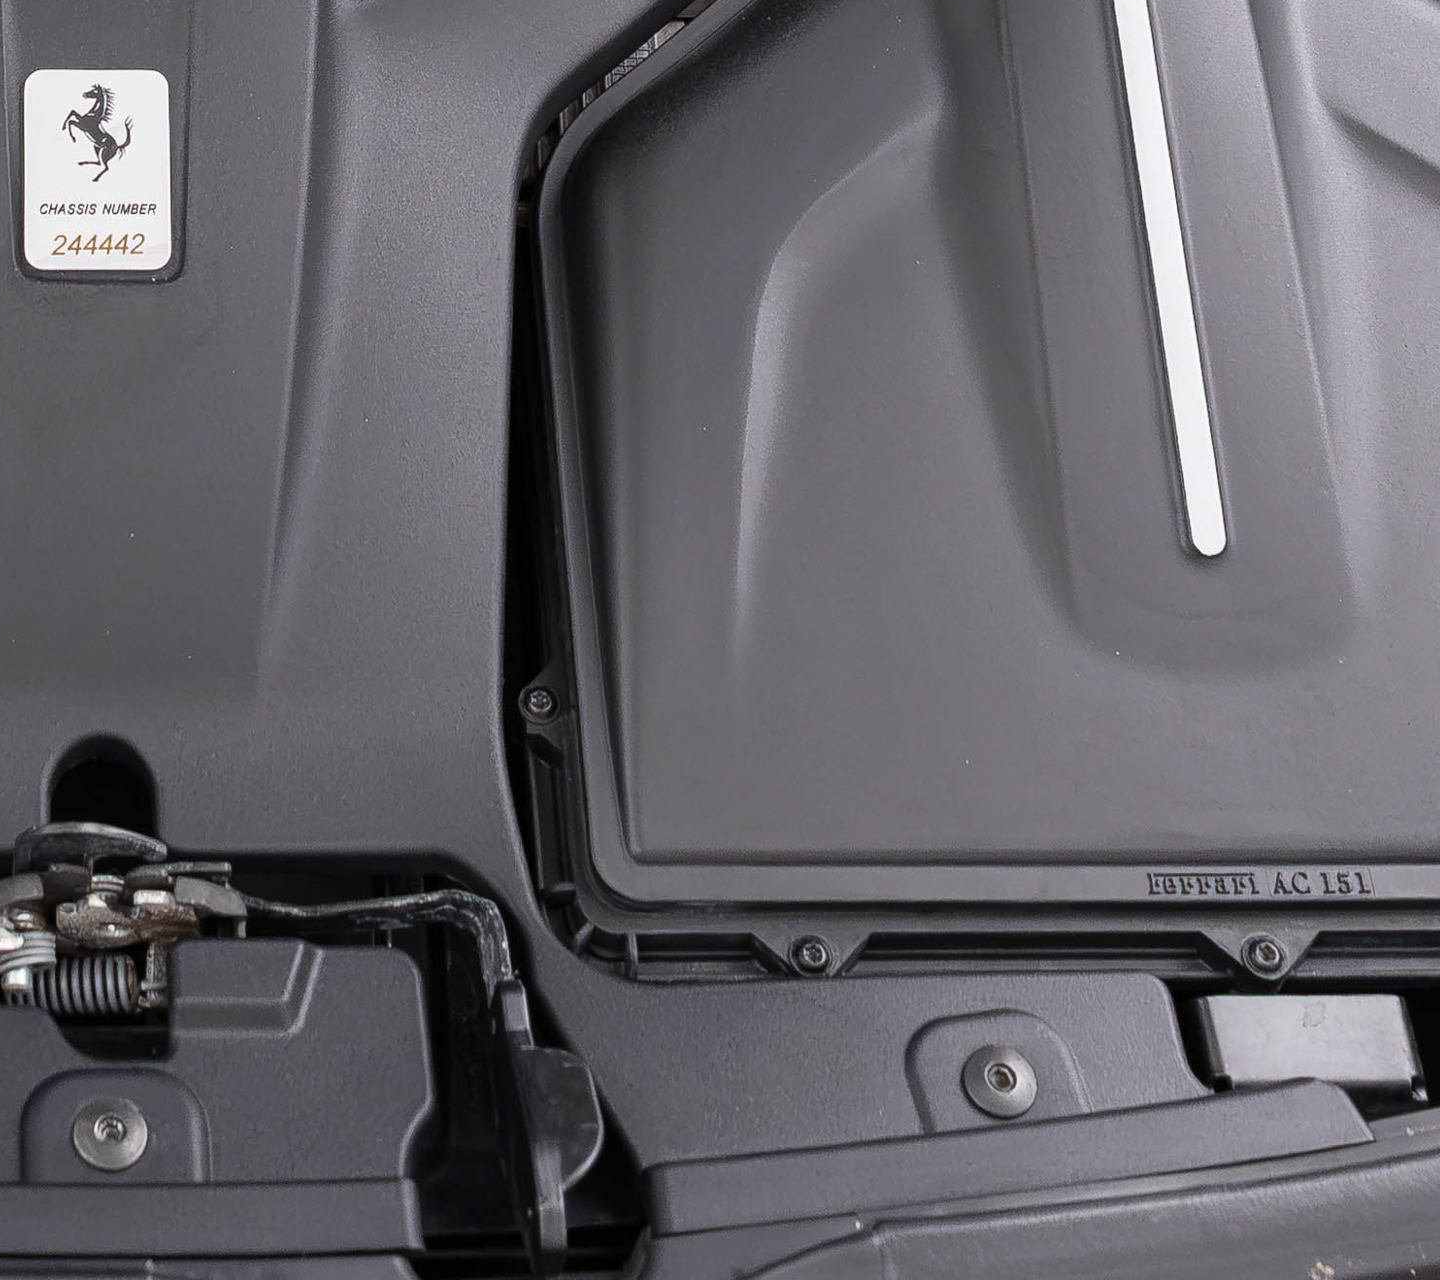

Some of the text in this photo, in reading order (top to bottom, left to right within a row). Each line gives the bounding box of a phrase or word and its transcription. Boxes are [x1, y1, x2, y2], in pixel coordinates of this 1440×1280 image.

[39, 203, 157, 215] CHASSIS NUMBER
[51, 233, 146, 256] 244442
[1147, 872, 1371, 895] Ferrari AC 151
